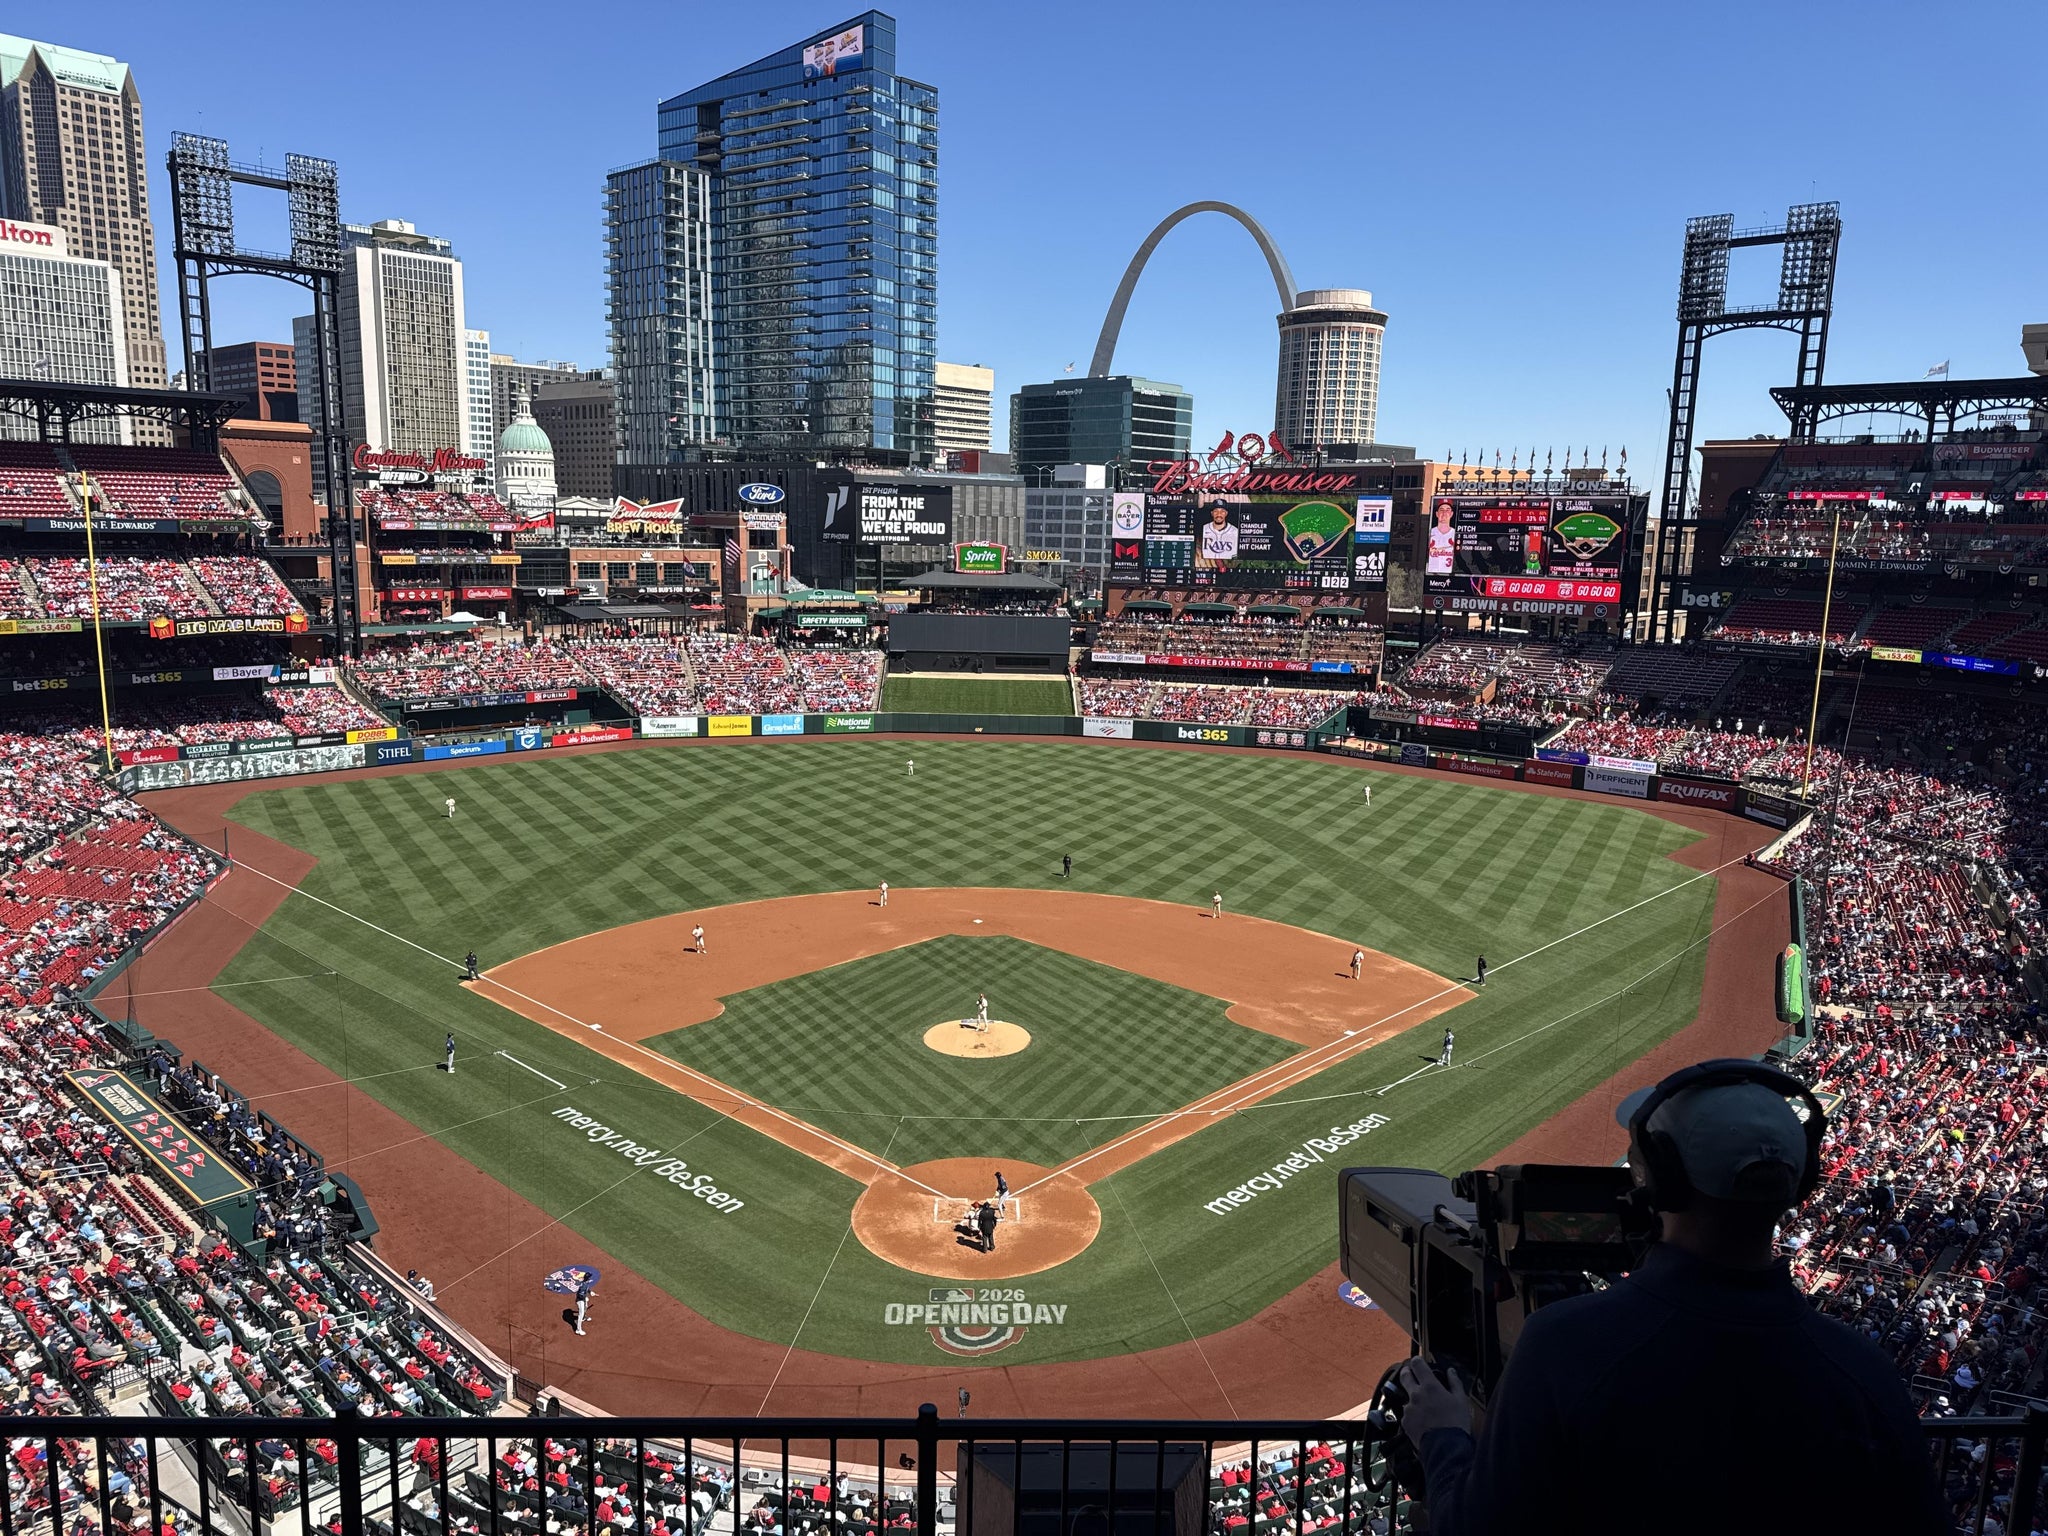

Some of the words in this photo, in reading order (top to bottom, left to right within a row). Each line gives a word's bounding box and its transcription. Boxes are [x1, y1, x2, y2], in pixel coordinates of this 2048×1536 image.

[1979, 413, 2033, 421] BUDWEISE
[353, 443, 426, 471] Cardinals
[425, 447, 488, 472] Nation
[434, 475, 475, 483] ROOFTOP
[1147, 458, 1356, 494] Budweiser
[1453, 480, 1508, 491] WORLD
[1512, 479, 1611, 492] CHAMPIONS
[749, 486, 776, 501] Ford
[861, 497, 899, 509] FROM
[900, 498, 925, 509] THE
[610, 504, 683, 520] Budweiser
[743, 512, 785, 522] Community
[861, 509, 887, 521] LOU
[889, 509, 915, 522] AND
[50, 519, 98, 530] BENJAMN
[606, 522, 641, 533] BREW
[643, 522, 683, 534] HOUSE
[861, 521, 901, 534] WE'RE
[904, 521, 946, 535] PROUD
[964, 550, 997, 563] Sprite
[1026, 550, 1062, 560] SMOKE
[1823, 560, 1867, 569] BNJAMIN
[1429, 580, 1446, 588] Mercy
[1509, 583, 1520, 593] GO
[1522, 583, 1532, 594] GO
[1534, 584, 1545, 594] GO
[1578, 585, 1589, 596] GO
[1591, 586, 1602, 596] GO
[1604, 586, 1616, 597] GO
[1452, 598, 1498, 611] BROWN
[1501, 602, 1509, 612] &
[1512, 601, 1584, 616] CROUPPEN
[176, 622, 206, 634] BIG
[208, 620, 244, 633] MAC
[246, 619, 284, 632] LAND
[1182, 658, 1242, 668] SCOREBOARD
[1246, 661, 1274, 669] PATIO
[132, 672, 182, 684] bet365
[232, 667, 263, 678] Bayer
[12, 679, 68, 692] bet365
[542, 692, 568, 700] PURINA
[837, 718, 872, 726] National
[357, 730, 388, 739] DOBBS
[580, 732, 620, 743] Budweiser
[1178, 726, 1228, 741] bet365
[186, 744, 229, 753] ROTTLER
[250, 742, 273, 750] Central
[450, 746, 479, 755] Spectrum
[378, 746, 412, 760] STIFEL
[1461, 763, 1502, 775] Budweiser
[1660, 782, 1730, 802] EQUIFAX
[551, 1106, 745, 1214] mercy.net/BeSeen
[1203, 1112, 1391, 1216] mercy.net/BeSeen
[979, 1288, 1026, 1302] 2026
[884, 1303, 1008, 1325] OPENING
[1012, 1304, 1068, 1325] DAY
